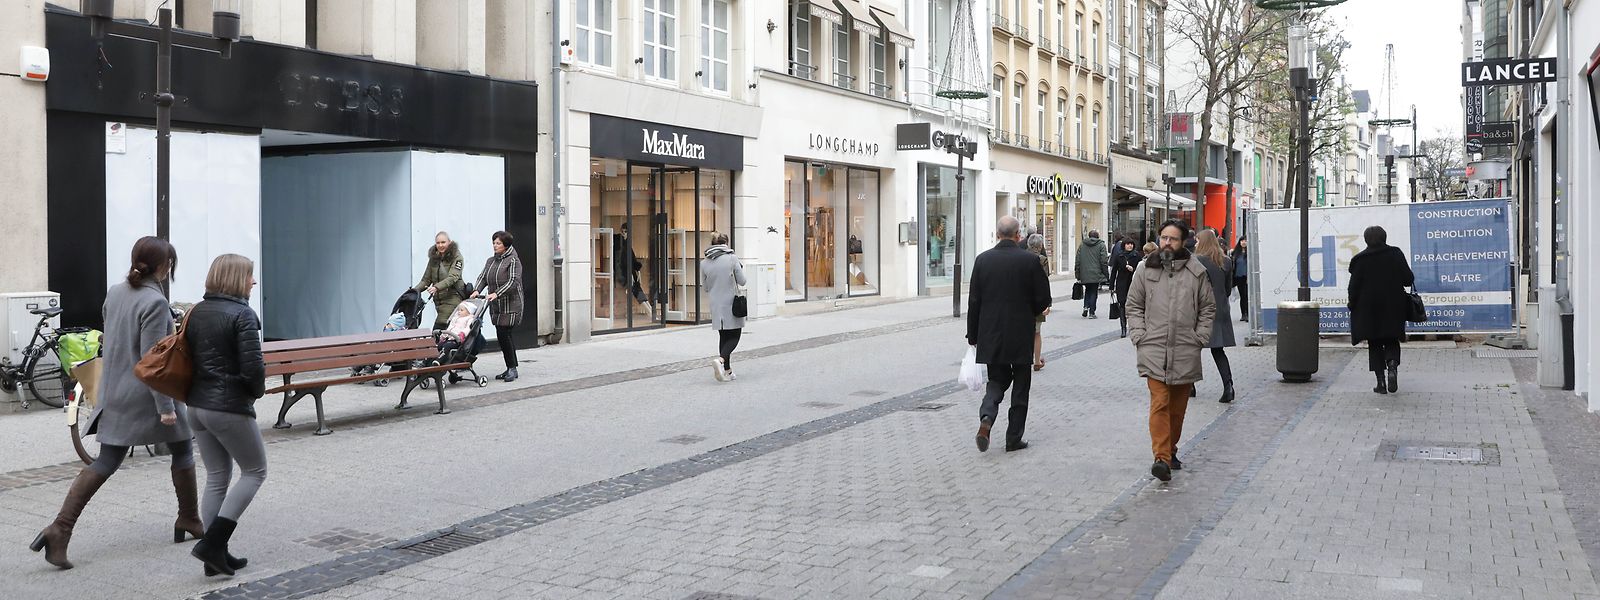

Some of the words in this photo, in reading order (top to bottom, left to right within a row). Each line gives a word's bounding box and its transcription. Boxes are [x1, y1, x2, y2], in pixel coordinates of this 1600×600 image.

[1466, 62, 1555, 82] LANCEL
[1482, 129, 1513, 138] ba&sh
[641, 128, 705, 160] MaxMara
[809, 133, 879, 156] LONGCHAMP
[1417, 207, 1501, 219] CONSTRUCTION
[1426, 228, 1493, 239] DÉMOLITION
[1414, 251, 1508, 262] PARACHEVEMENT
[1441, 272, 1481, 283] PLÂTRE
[1423, 295, 1483, 304] 3groupe.eu
[1433, 309, 1441, 317] 19
[1443, 309, 1453, 317] 00
[1455, 309, 1465, 317] 99
